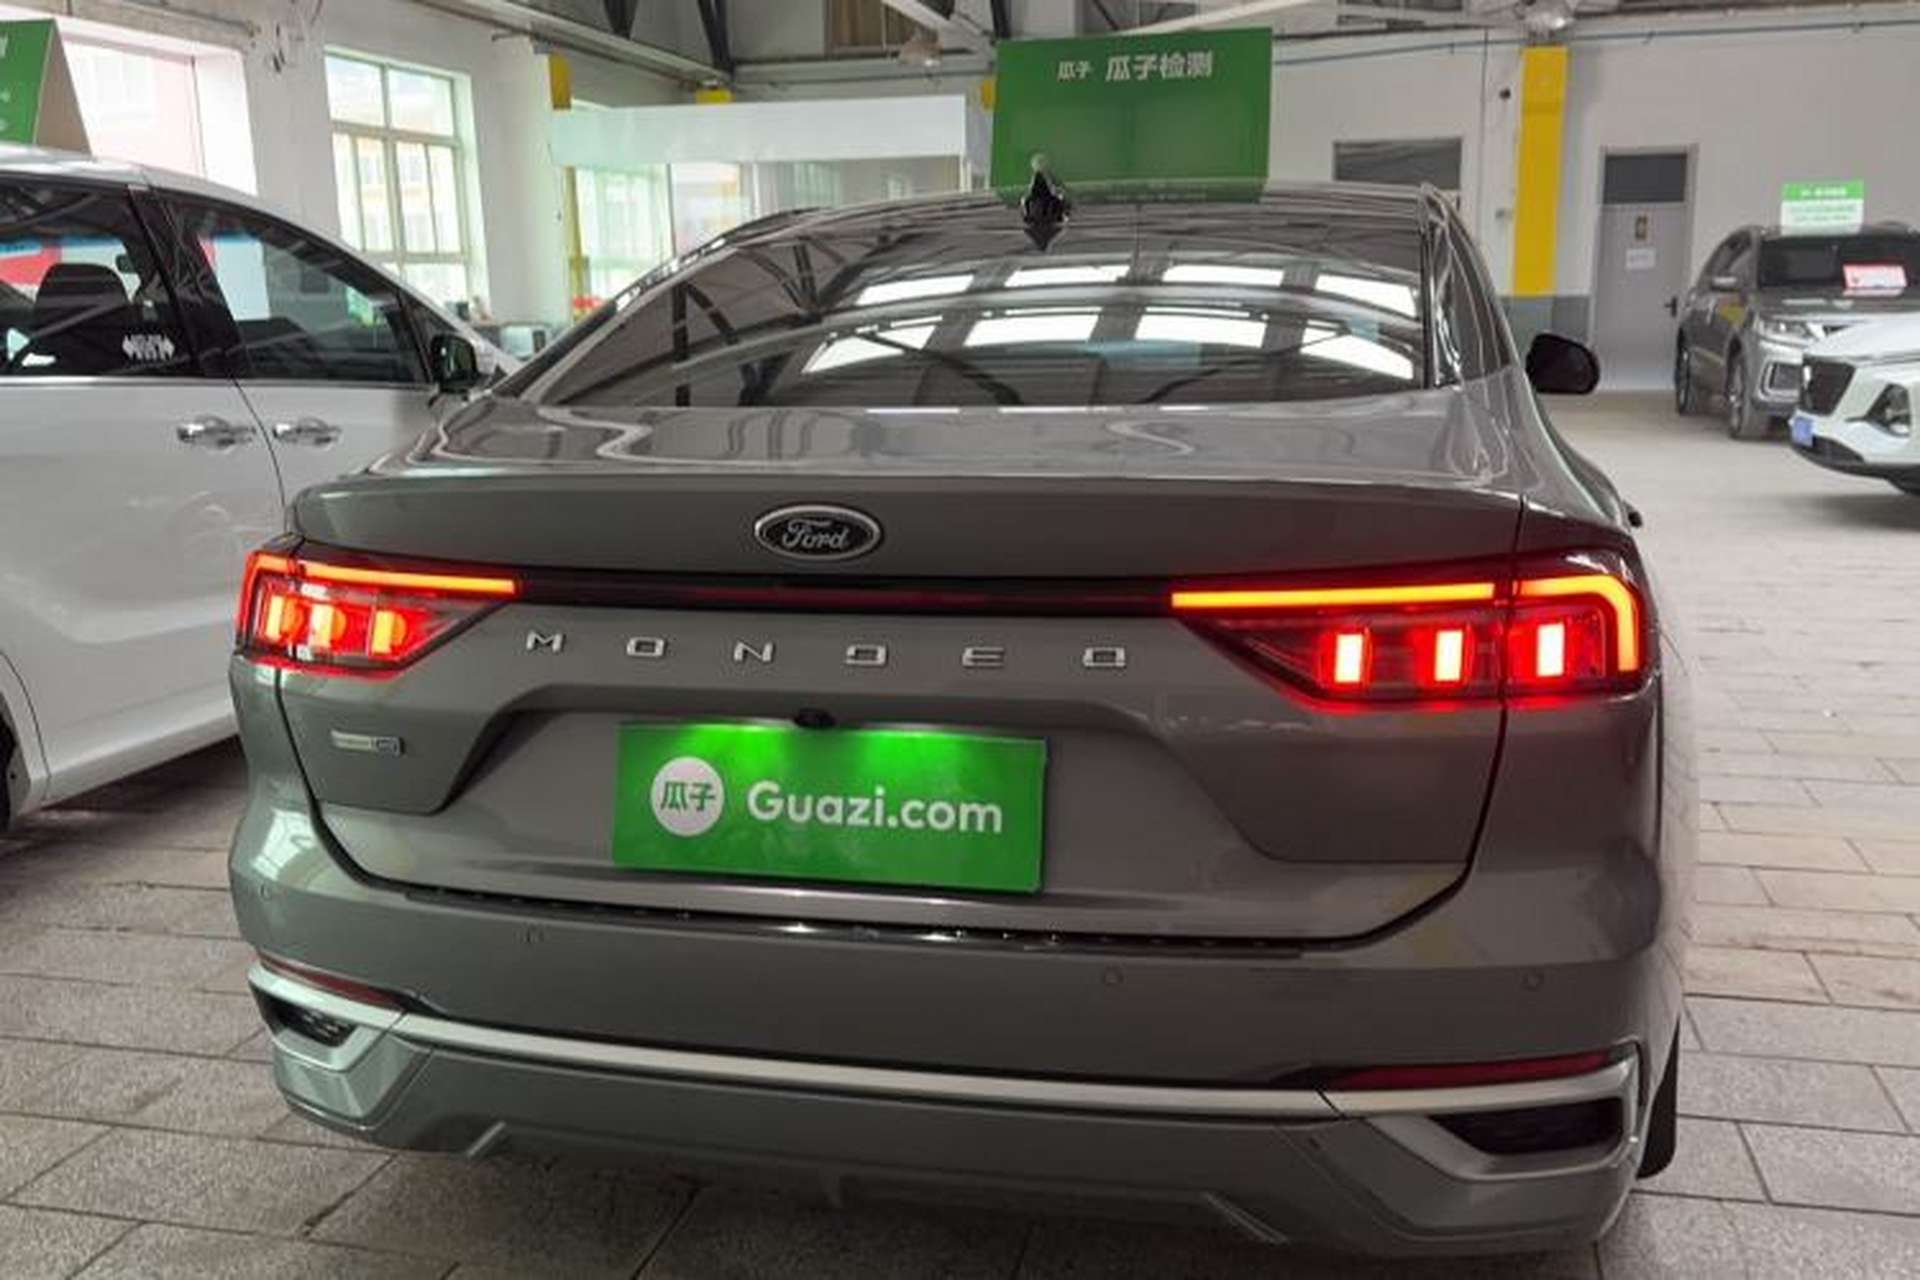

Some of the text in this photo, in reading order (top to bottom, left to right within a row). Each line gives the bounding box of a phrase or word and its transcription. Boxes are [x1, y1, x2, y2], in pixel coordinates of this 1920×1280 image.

[1105, 50, 1214, 82] 瓜子检测
[782, 518, 850, 549] Ford
[525, 630, 1126, 668] MONDEO
[660, 780, 716, 812] 瓜子
[746, 780, 1002, 834] Guazi.com
